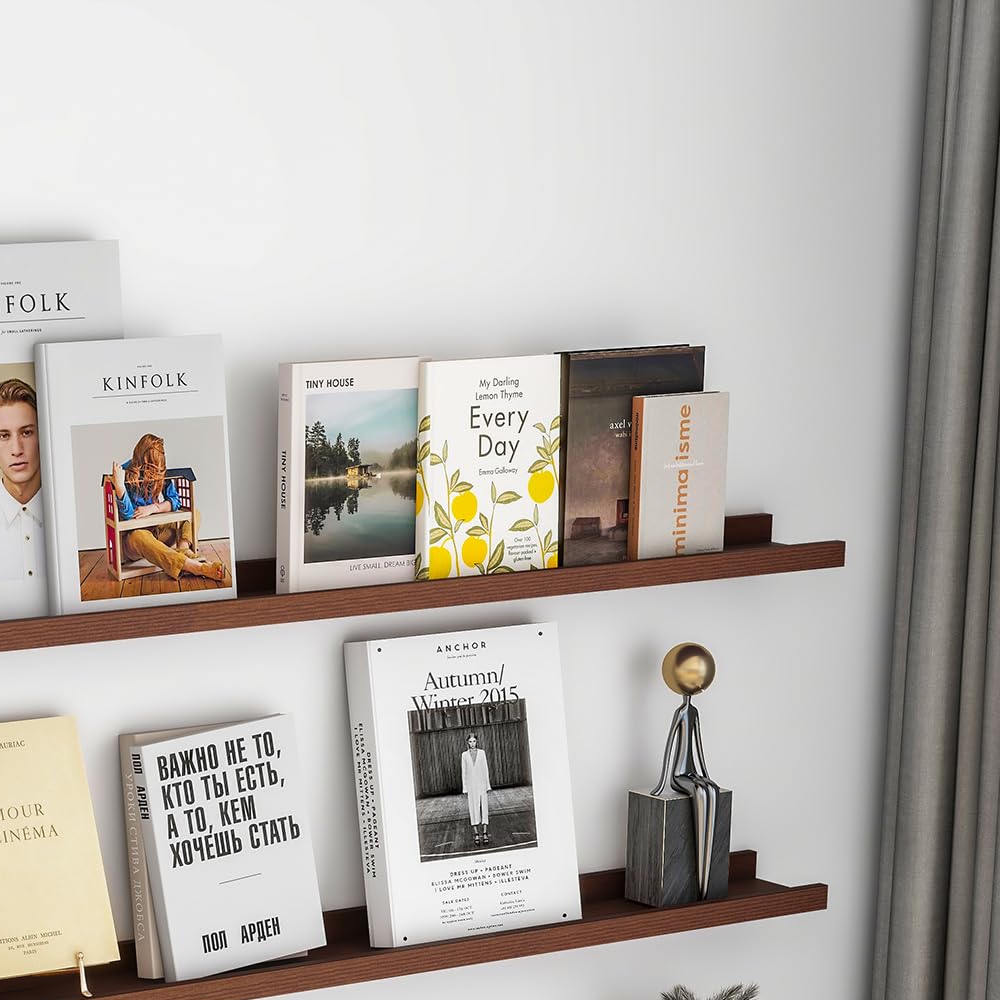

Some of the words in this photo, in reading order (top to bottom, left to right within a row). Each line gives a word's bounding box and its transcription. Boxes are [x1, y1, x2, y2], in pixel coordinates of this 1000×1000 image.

[102, 372, 188, 391] KINFOLK
[306, 379, 324, 388] TINY
[327, 378, 354, 388] HOUSE
[475, 391, 498, 400] Lemon
[500, 390, 523, 401] Thyme
[479, 379, 491, 388] My
[493, 377, 519, 388] Darling
[470, 405, 529, 434] Every
[609, 419, 626, 429] axel
[478, 434, 520, 463] Day
[495, 467, 518, 476] Galloway
[436, 641, 487, 653] ANCHOR
[424, 664, 505, 691] Autumn/
[411, 694, 474, 712] Winter
[480, 685, 519, 704] 2015
[132, 754, 142, 774] ПОЛ
[157, 744, 219, 781] ВАЖНО
[225, 738, 248, 766] НЕ
[252, 731, 281, 759] ТО,
[161, 780, 195, 810] КТО
[201, 772, 230, 800] ТЫ
[235, 762, 285, 792] ЕСТЬ,
[362, 758, 370, 807] MCGOWAN
[369, 784, 375, 796] UP
[127, 774, 135, 821] УРОКИ
[136, 786, 150, 820] АРДЕН
[167, 813, 179, 839] А
[184, 807, 213, 834] ТО,
[219, 795, 257, 827] КЕМ
[371, 806, 380, 849] PAGEANT
[130, 826, 139, 875] СТИВА
[170, 829, 242, 868] ХОЧЕШЬ
[248, 815, 300, 850] СТАТЬ
[454, 875, 486, 883] MCGOWAN
[133, 880, 145, 942] ДЖОБСА
[202, 930, 228, 953] ПОЛ
[241, 917, 280, 944] АРДЕН
